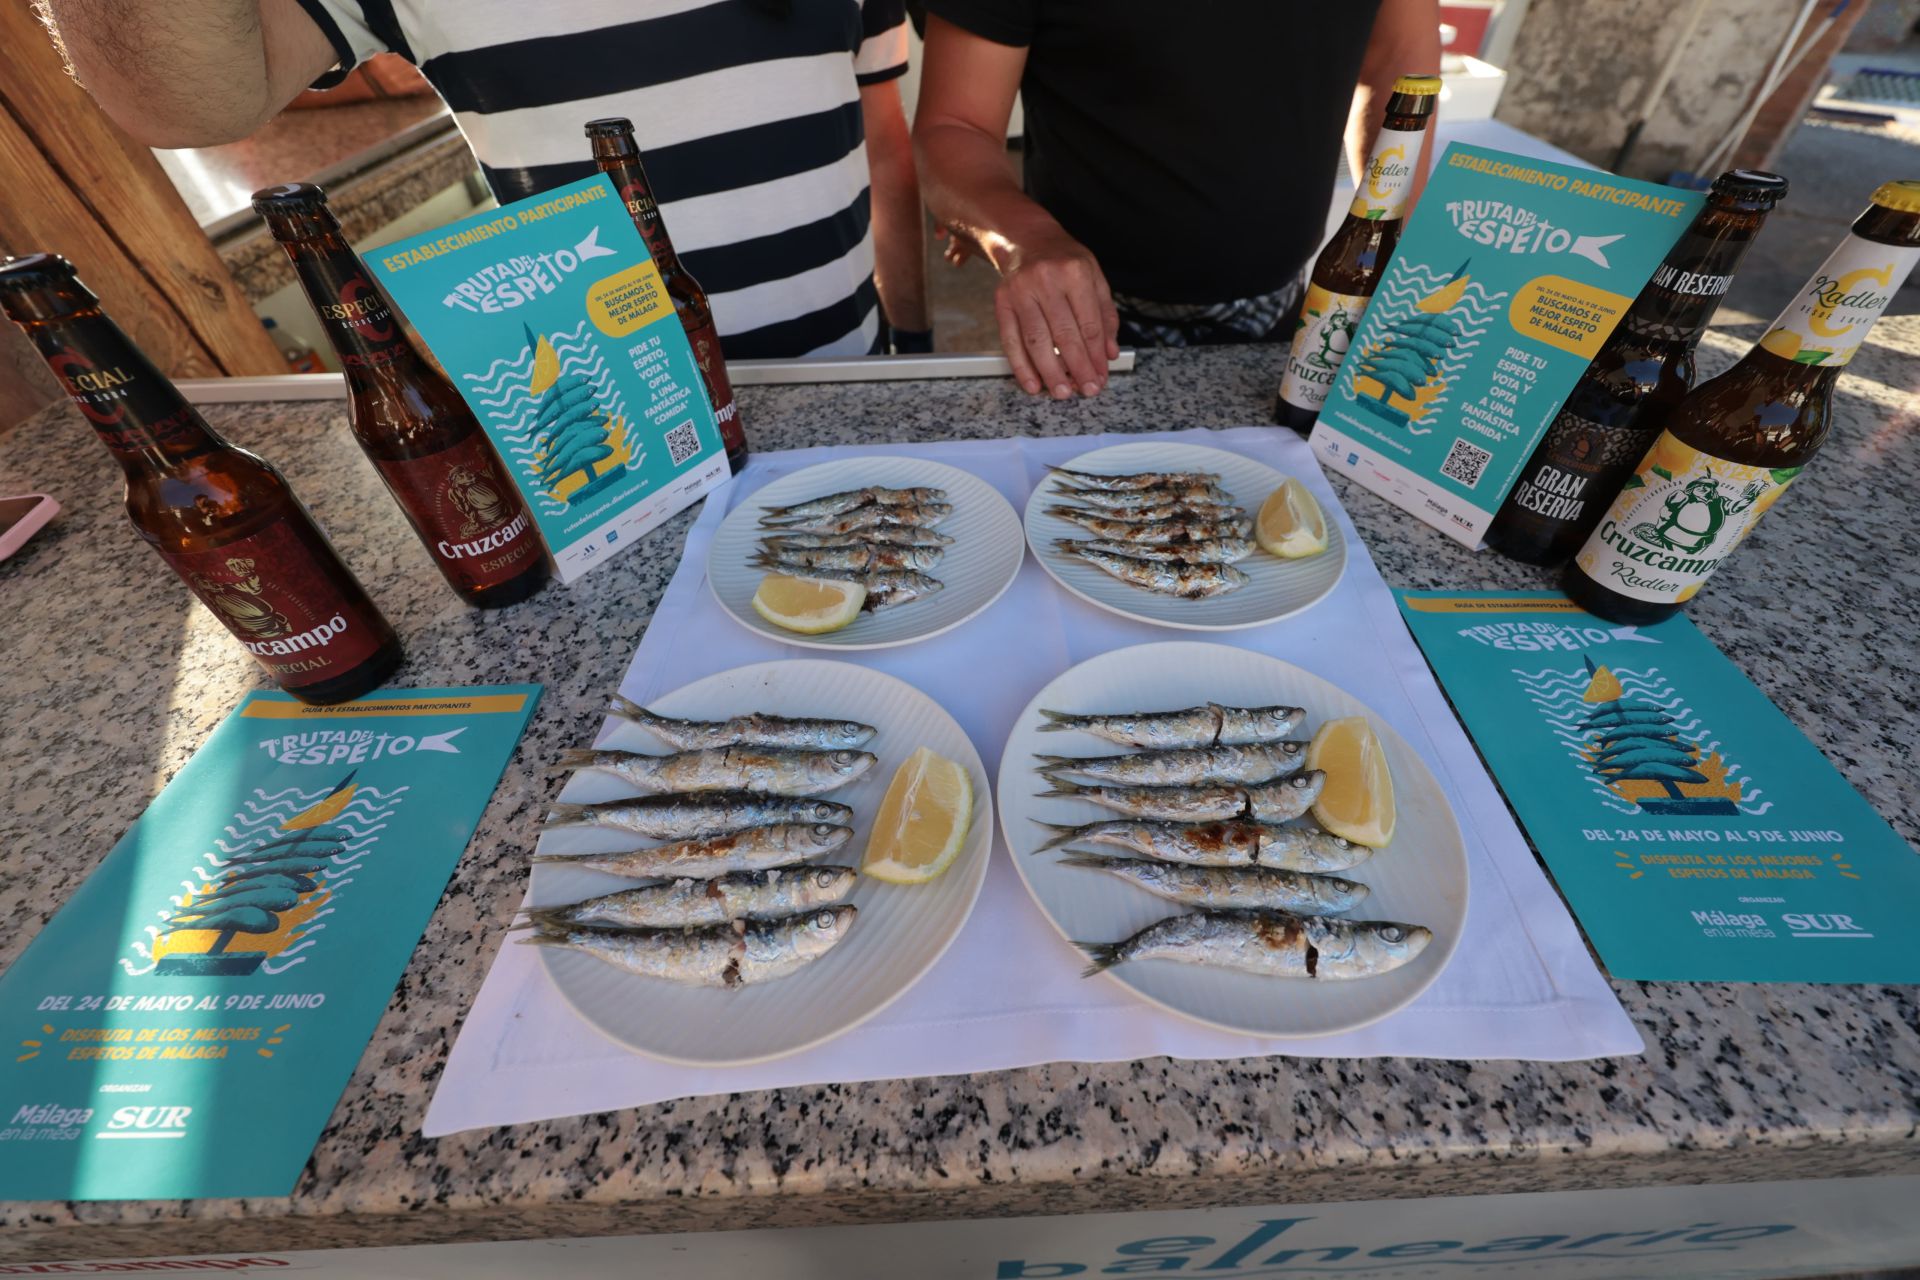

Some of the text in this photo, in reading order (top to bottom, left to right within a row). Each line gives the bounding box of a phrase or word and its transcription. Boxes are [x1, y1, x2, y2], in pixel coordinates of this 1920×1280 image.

[1366, 156, 1409, 178] Radler
[1448, 153, 1686, 218] ESTABLECIMIENTO PARTICIPANTE
[1463, 200, 1513, 222] RUTA
[1514, 208, 1537, 227] DEL
[382, 184, 608, 273] ESTABLECIMIENTO PARTICIPANTE
[1458, 218, 1571, 254] ESPETO
[454, 261, 514, 302] RUTA
[510, 254, 537, 275] DEL
[480, 249, 578, 314] ESPETO
[604, 287, 645, 308] BUSCAMOS
[645, 283, 654, 291] EL
[608, 290, 658, 318] MEJOR ESPETO
[1808, 275, 1887, 310] Radler
[617, 302, 659, 325] DE MÁLAGA
[1530, 304, 1597, 333] MEJOR ESPETO
[1537, 295, 1602, 323] BUSCAMOS EL
[1529, 316, 1585, 342] DE MÁLAGA
[628, 335, 661, 358] PIDE TU
[1505, 346, 1548, 370] PIDE TU
[633, 349, 666, 370] ESPETO,
[638, 358, 670, 380] VOTA Y
[1497, 359, 1537, 383] ESPETO,
[648, 372, 671, 389] OPTA
[651, 382, 678, 402] A UNA
[1492, 371, 1533, 395] VOTA Y
[644, 386, 691, 418] FANTÁSTICA
[1489, 386, 1518, 404] OPTA
[1460, 402, 1520, 436] FANTÁSTICA
[1479, 397, 1514, 418] A UNA
[1534, 465, 1588, 498] GRAN
[1514, 481, 1584, 521] RESERVA
[1610, 561, 1679, 593] Radler
[1473, 622, 1536, 640] RUTA
[1536, 622, 1559, 633] DEL
[1493, 625, 1610, 650] ESPETO
[302, 702, 471, 713] GUÍA DE ESTABLECIMIENTOS PARTICIPANTES
[277, 732, 415, 765] ESPETO
[283, 730, 346, 752] RUTA
[347, 729, 375, 743] DEL
[1582, 829, 1844, 843] DEL 24 DE MAYO AL 9 DE JUNIO
[1639, 854, 1824, 866] DISFRUTA DE LOS MEJORES
[1667, 867, 1816, 879] ESPETOS DE MÁLAGA
[1691, 910, 1863, 930] Málaga SUR
[36, 993, 325, 1011] DEL 24 DE MAYO AL 9 DE JUNIO
[60, 1027, 262, 1042] DISFRUTA DE LOS MEJORES
[66, 1045, 229, 1060] ESPETOS DE MÁLAGA
[10, 1104, 192, 1129] Málaga SUR
